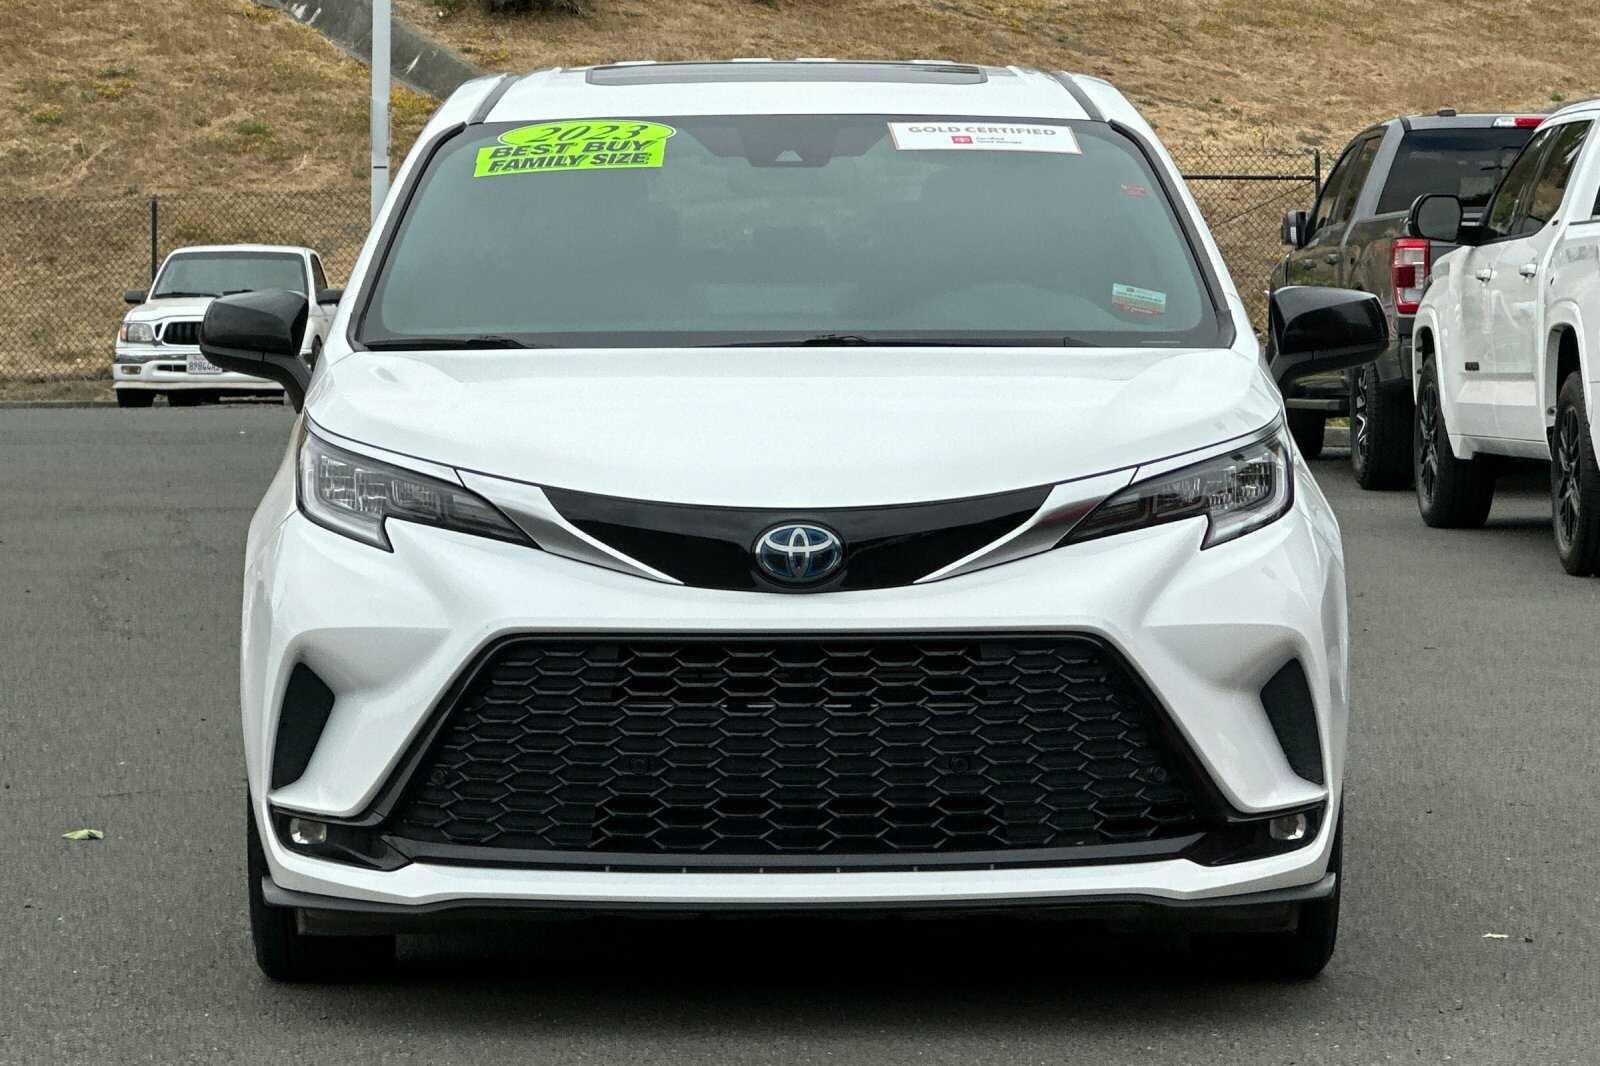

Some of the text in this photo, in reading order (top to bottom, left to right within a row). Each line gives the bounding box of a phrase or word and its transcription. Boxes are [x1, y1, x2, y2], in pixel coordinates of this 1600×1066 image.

[524, 125, 648, 143] 2023
[964, 126, 1057, 136] CERTIFIED
[488, 140, 657, 159] BEST BUY
[488, 154, 586, 173] FAMILY
